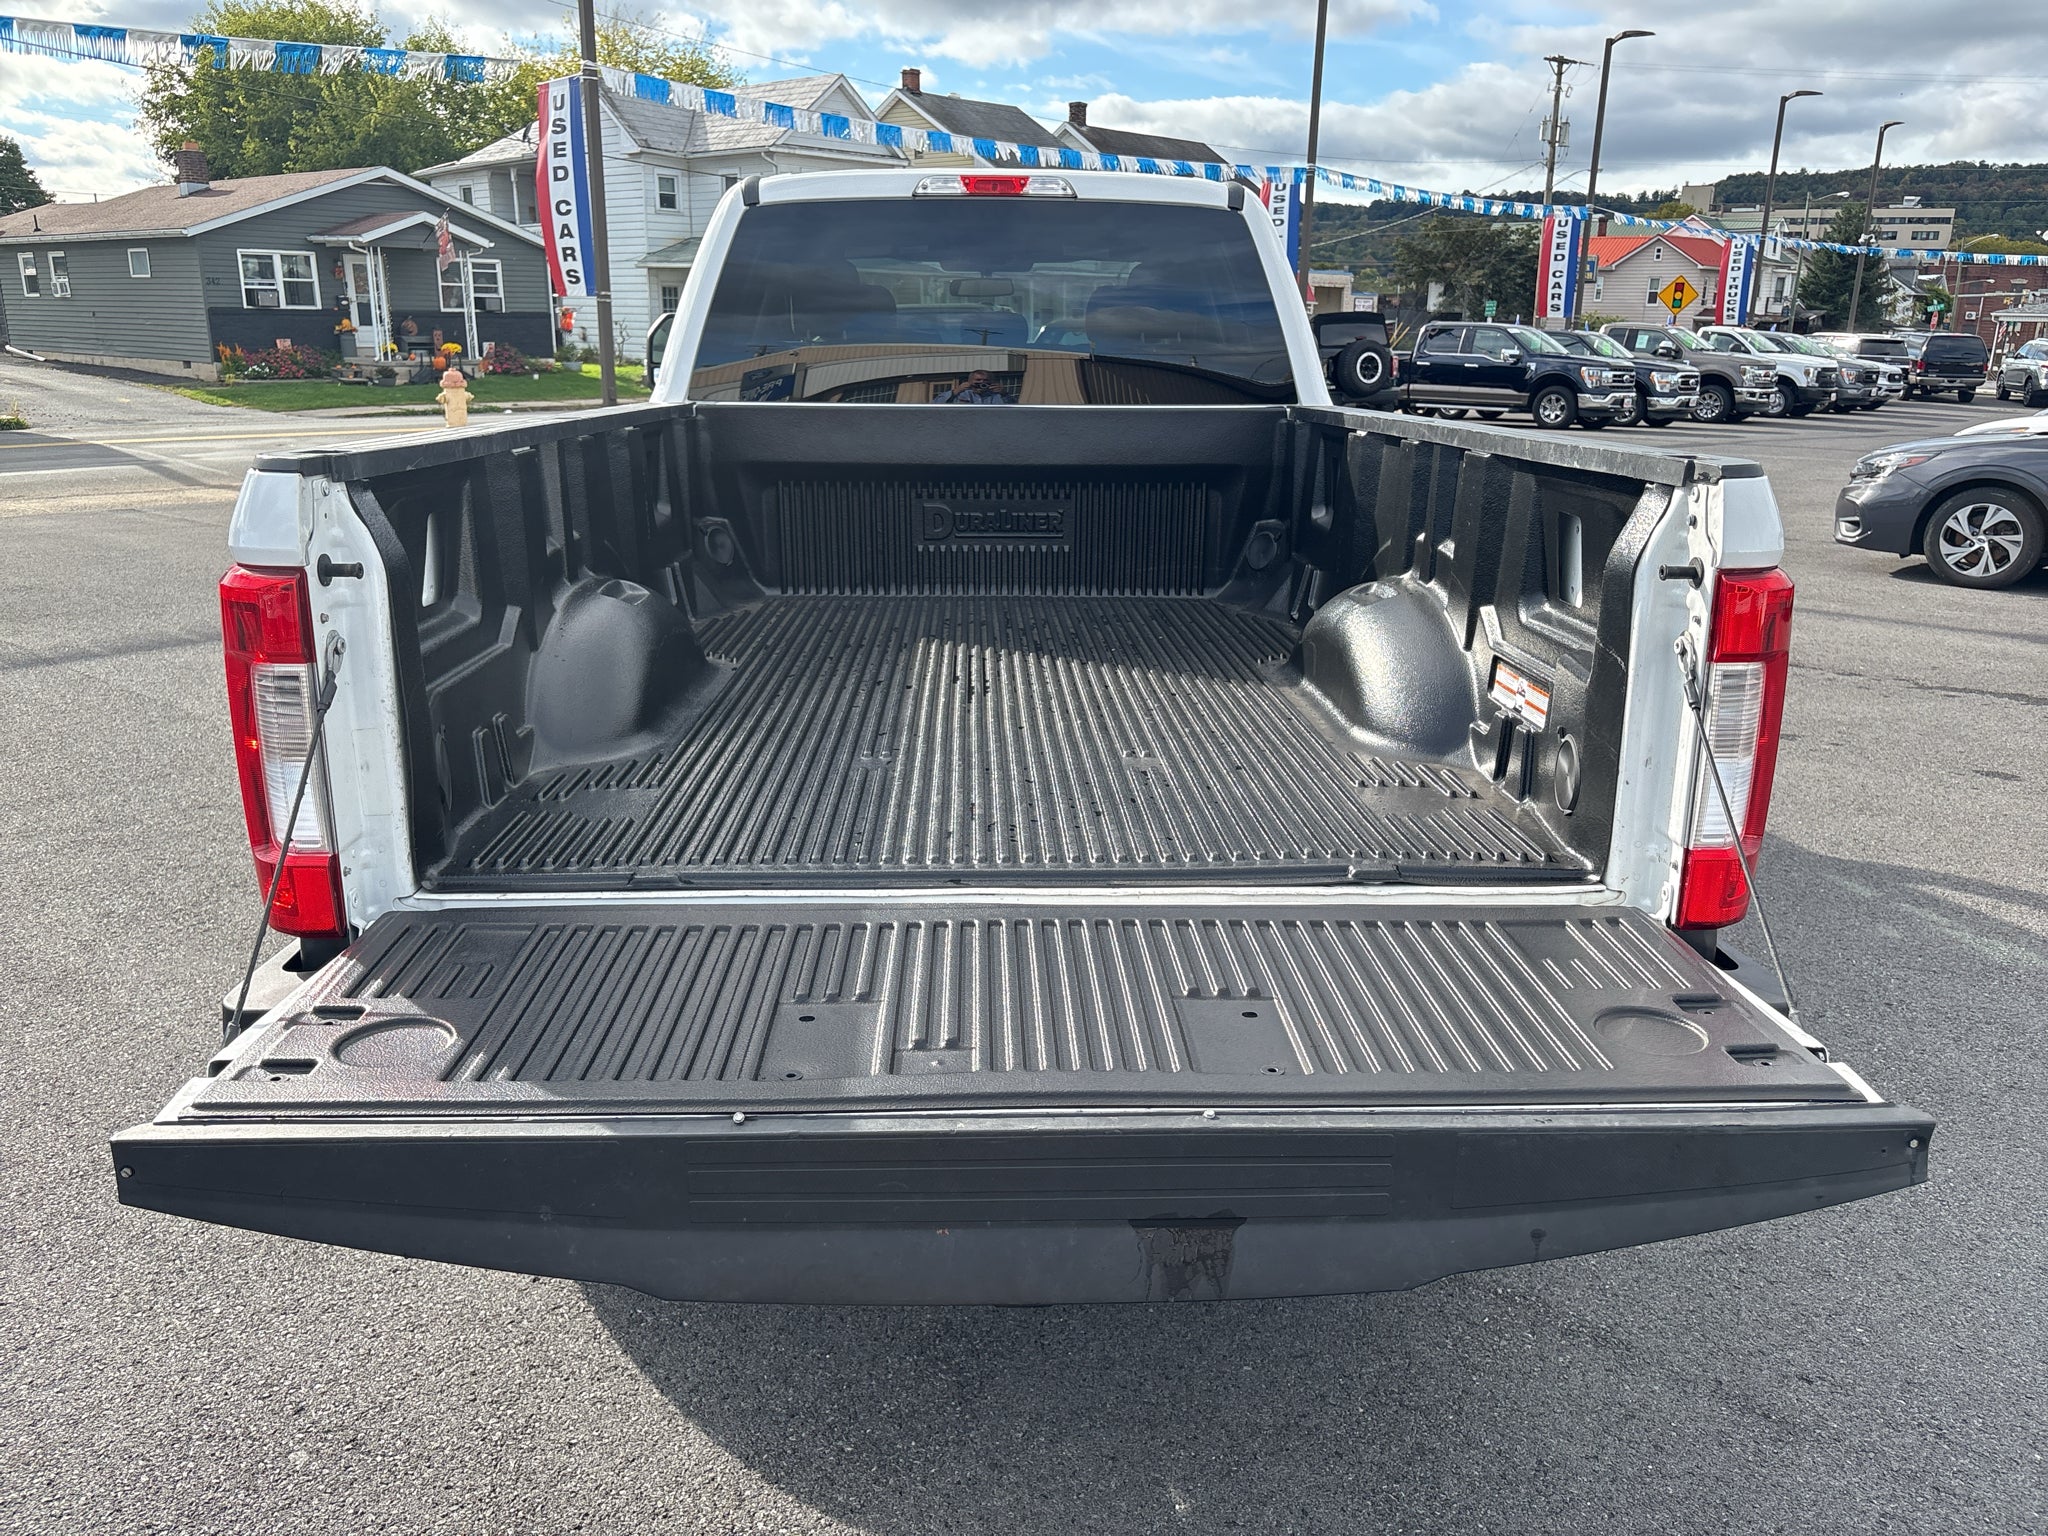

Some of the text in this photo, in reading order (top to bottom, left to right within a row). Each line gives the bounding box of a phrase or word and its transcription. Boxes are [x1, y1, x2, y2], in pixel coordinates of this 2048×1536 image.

[551, 93, 581, 285] USED CARS
[1272, 183, 1286, 226] USED
[1550, 219, 1569, 312] USED CARS
[1726, 243, 1744, 320] USED TRUCKS
